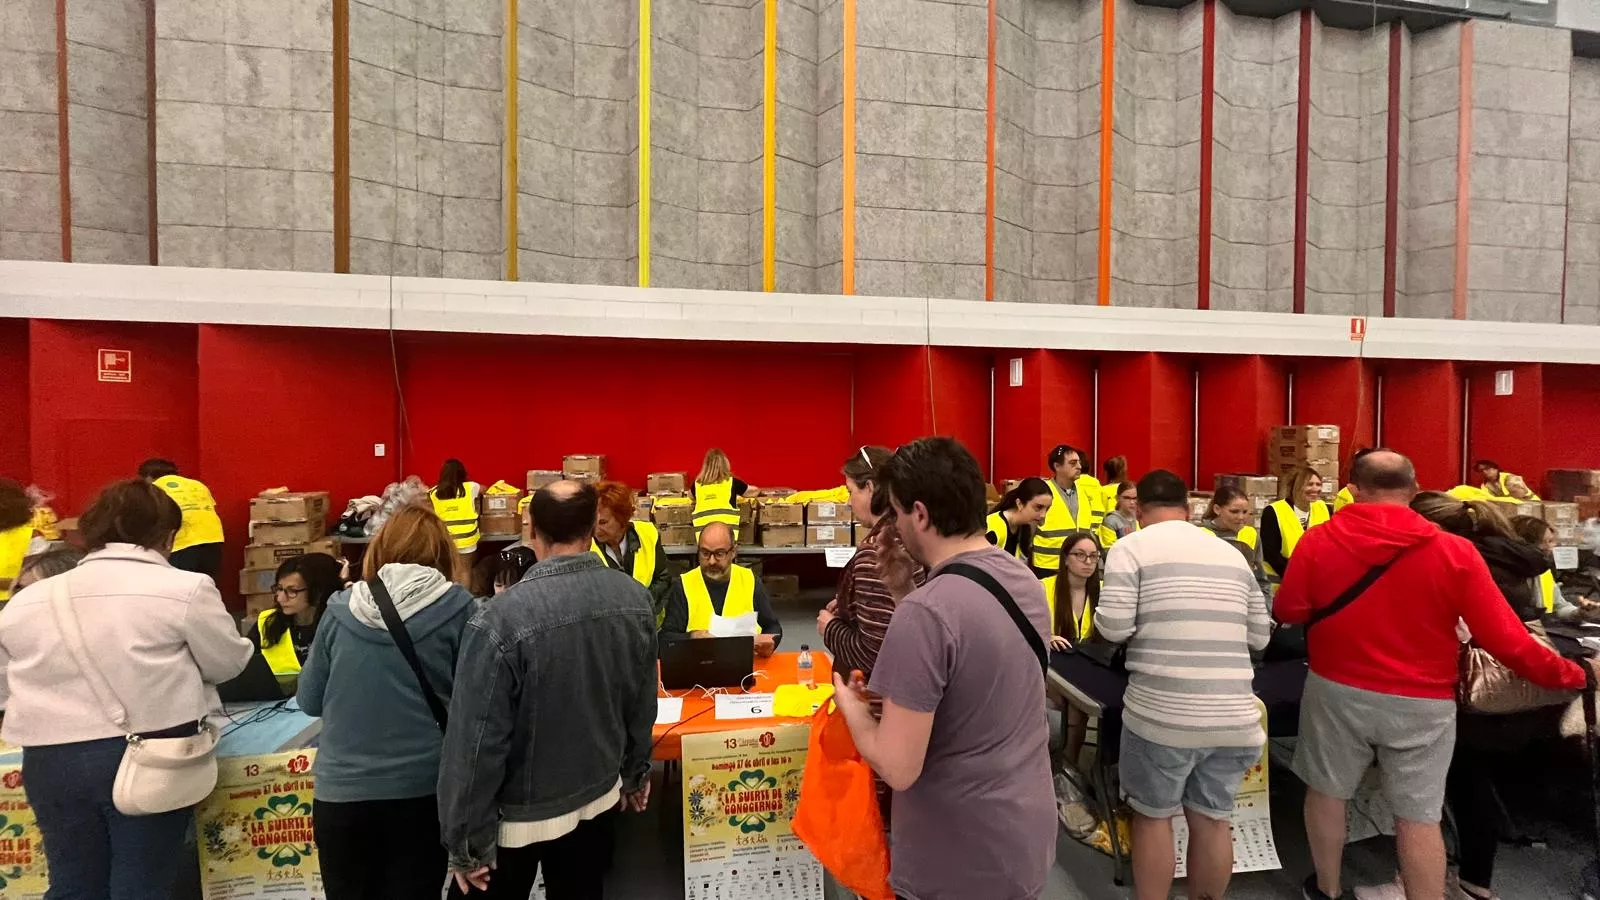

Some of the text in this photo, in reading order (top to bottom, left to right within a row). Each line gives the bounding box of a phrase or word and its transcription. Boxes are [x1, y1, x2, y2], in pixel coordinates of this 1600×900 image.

[751, 706, 762, 714] 6
[724, 739, 737, 749] 13
[244, 764, 260, 777] 13
[725, 788, 782, 804] LA SUERTE DE
[725, 800, 783, 815] CONOCERNOS
[251, 816, 314, 834] LA SUERTE D
[251, 829, 313, 847] CONOCERNO
